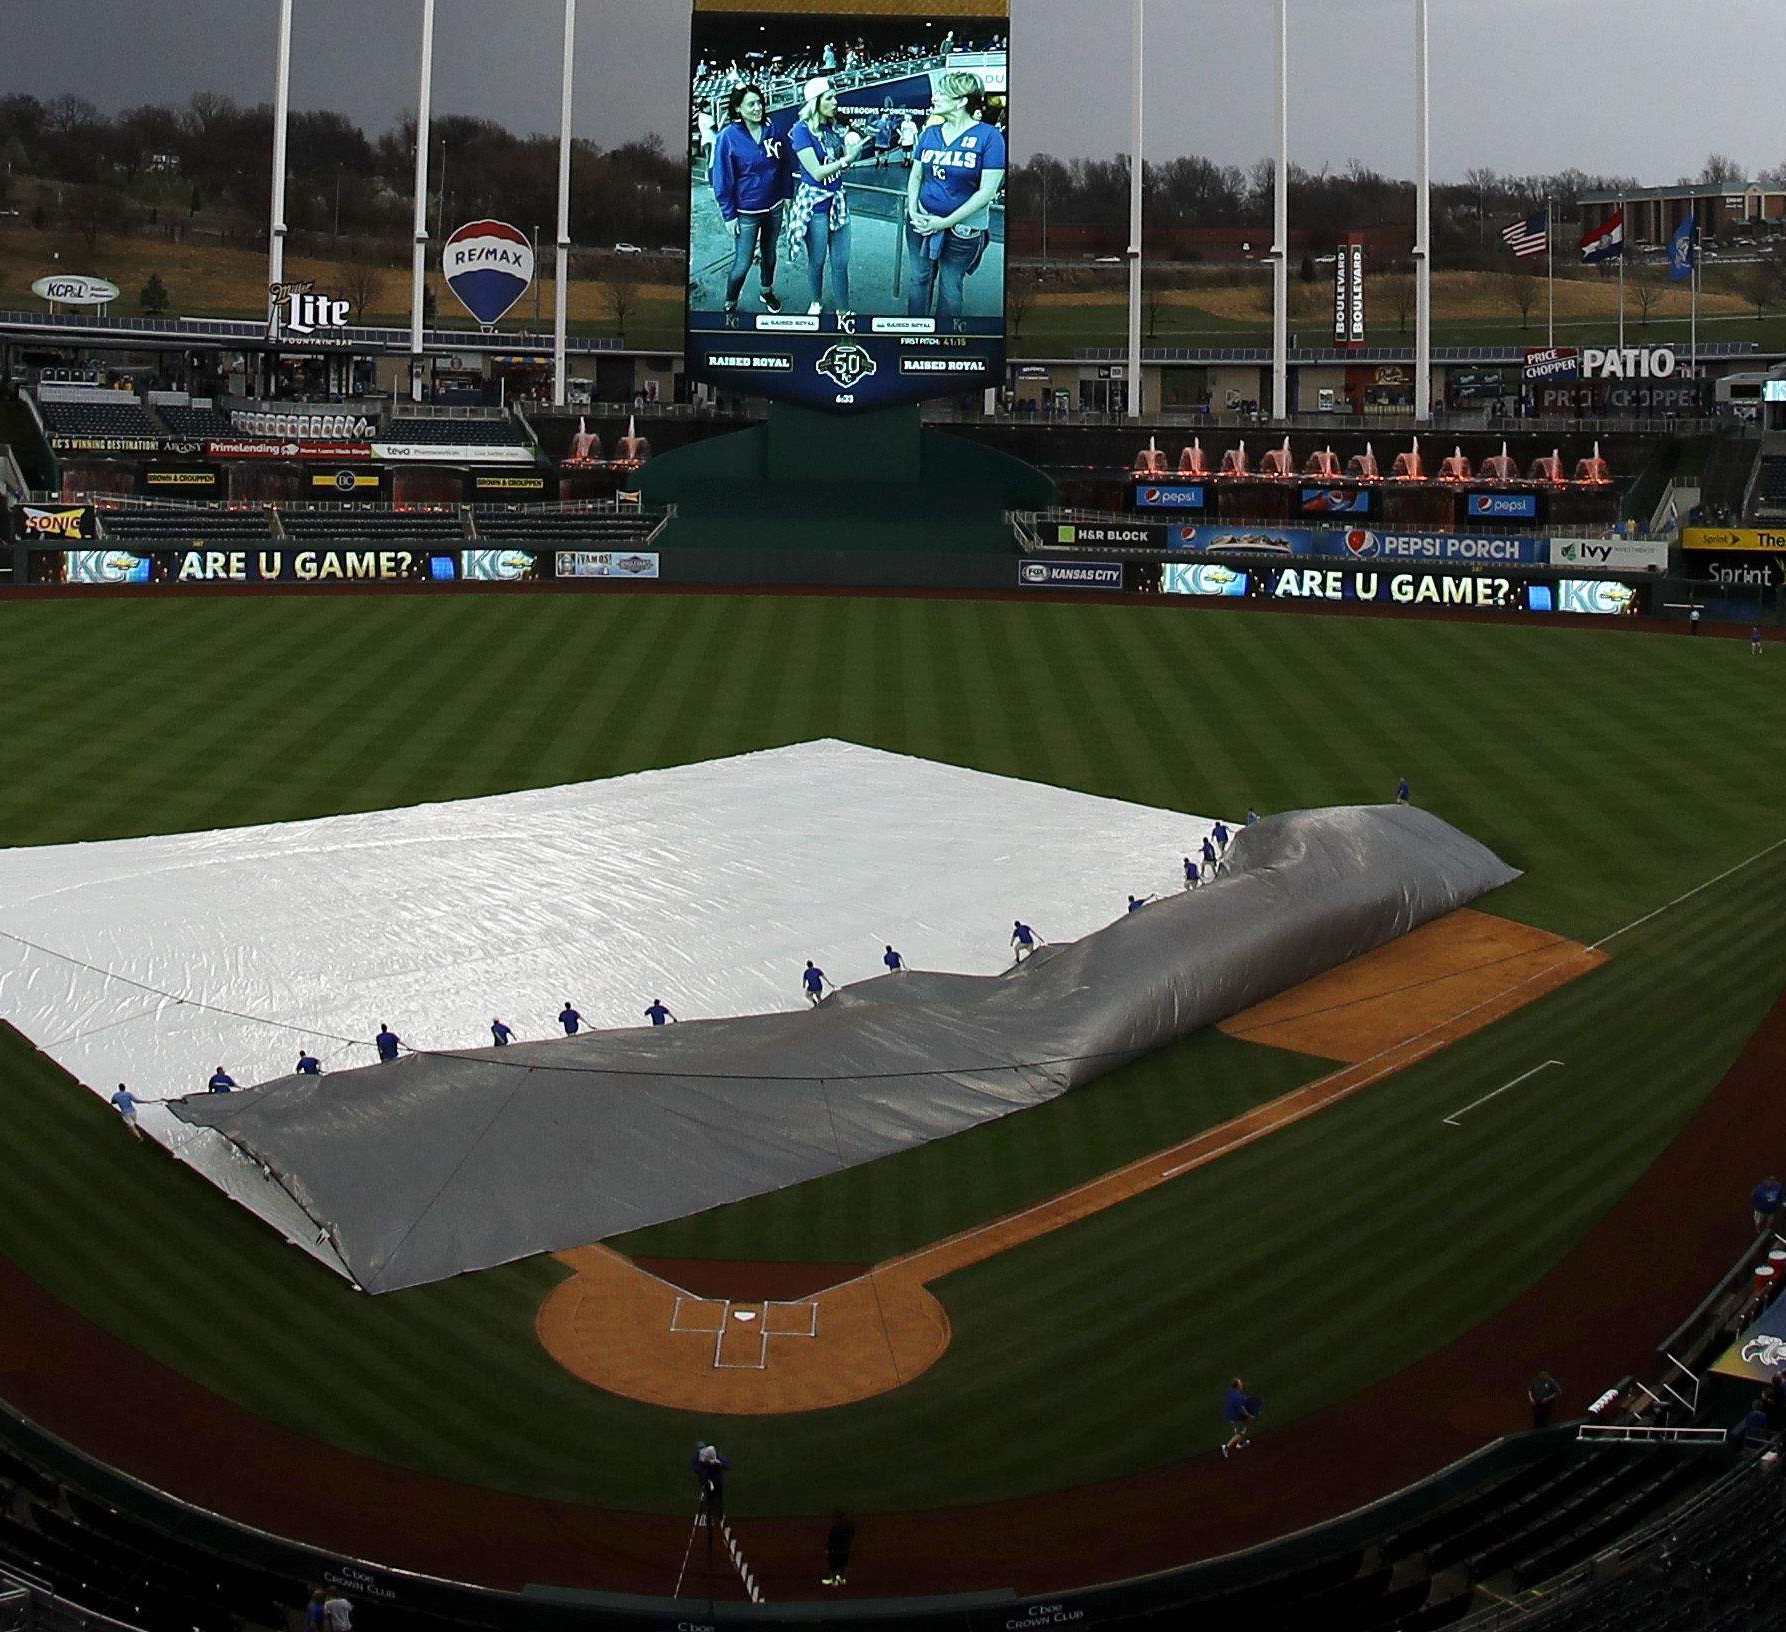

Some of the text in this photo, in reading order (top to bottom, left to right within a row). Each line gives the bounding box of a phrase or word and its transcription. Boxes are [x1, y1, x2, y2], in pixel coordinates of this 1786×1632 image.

[455, 246, 523, 268] RE/MAX
[47, 283, 84, 298] KCP&L
[270, 282, 313, 304] Miller
[1335, 252, 1346, 334] BOULEVARD
[1353, 252, 1363, 334] BOULEVARD
[287, 293, 350, 334] Lite
[837, 313, 855, 334] KC
[709, 356, 790, 368] RAISED ROYAL
[833, 354, 860, 373] 50
[1527, 349, 1558, 364] PRICE
[1583, 348, 1675, 378] PATIO
[904, 361, 985, 371] RAISED ROYAL
[1526, 359, 1576, 379] CHOPPER
[71, 439, 104, 450] WINNING
[163, 441, 203, 454] ARGOSY
[210, 442, 281, 456] PrimeLending
[1162, 492, 1195, 504] pepsi
[1494, 499, 1526, 512] pepsi
[28, 515, 81, 530] SONIC
[1078, 529, 1148, 542] H&R BLOCK
[1702, 534, 1728, 546] Sprint
[1757, 533, 1785, 547] The
[1384, 536, 1520, 559] PEPSI PORCH
[1581, 543, 1613, 561] Ivy
[179, 552, 246, 580] ARE
[259, 552, 280, 580] U
[295, 552, 412, 580] GAME?
[1051, 568, 1094, 580] KANSAS
[1095, 570, 1120, 581] CITY
[1709, 562, 1772, 587] Sprint
[1275, 569, 1343, 600] ARE
[1355, 573, 1378, 602] U
[1391, 574, 1511, 606] GAME?
[1005, 1609, 1084, 1630] CROWN CLUB
